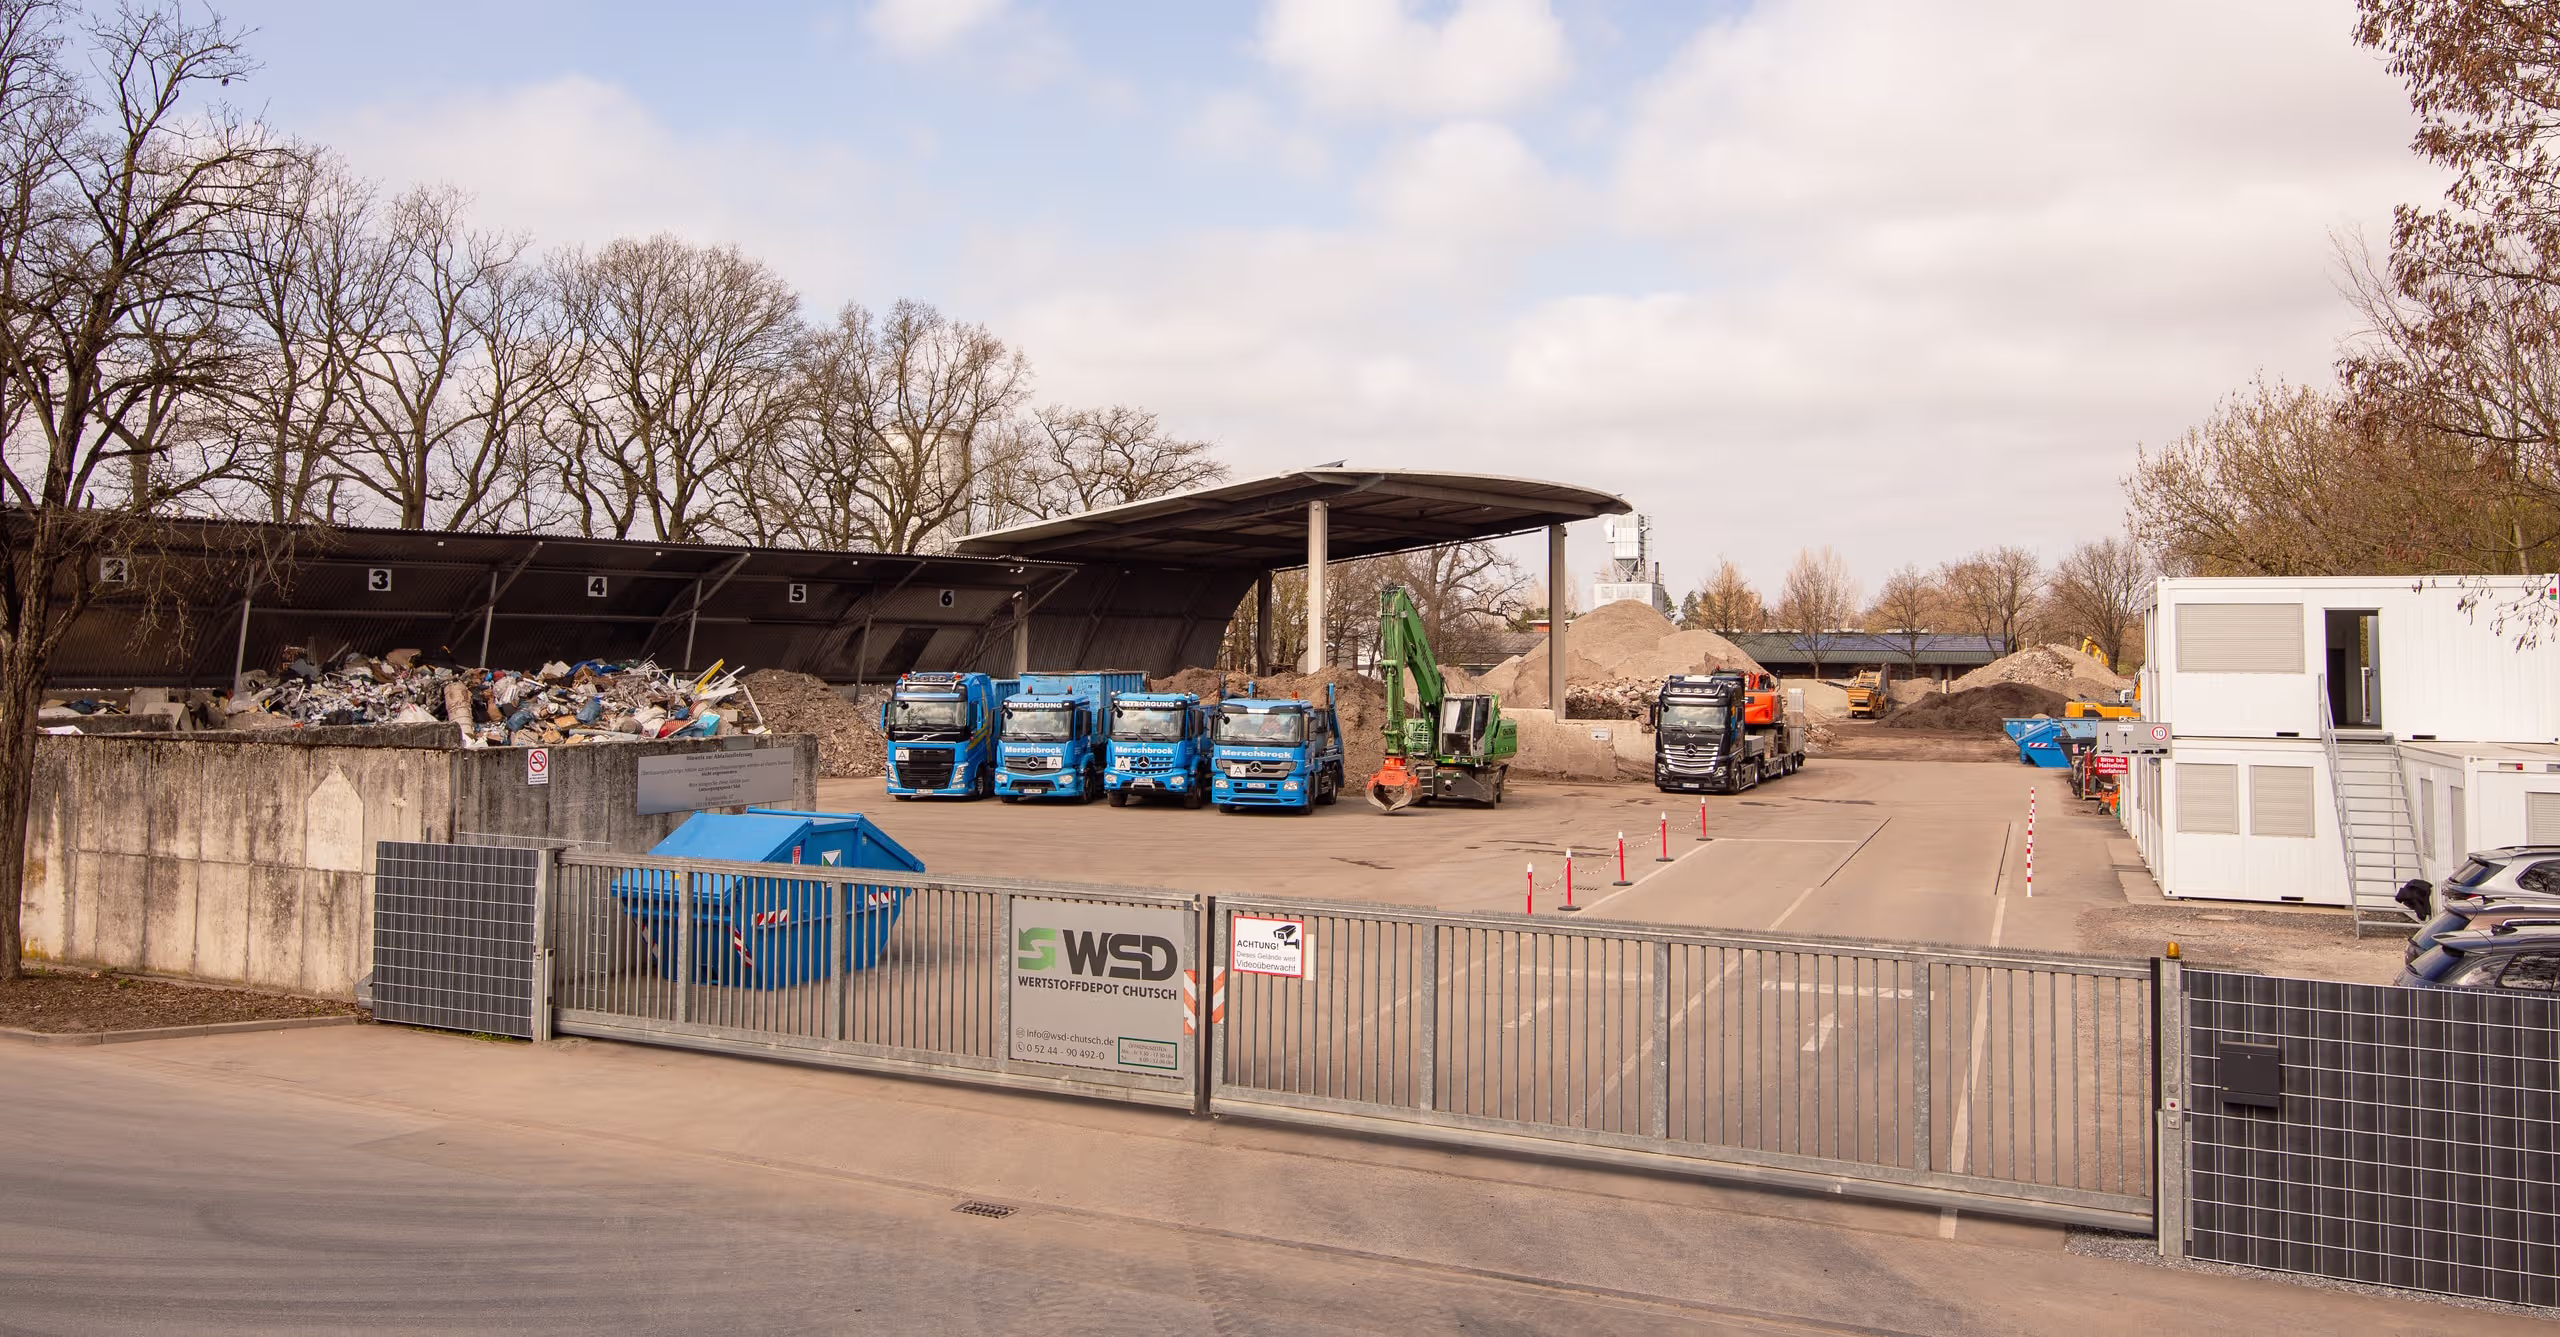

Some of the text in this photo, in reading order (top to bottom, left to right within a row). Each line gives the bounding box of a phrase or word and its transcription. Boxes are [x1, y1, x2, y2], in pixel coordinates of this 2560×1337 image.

[106, 559, 124, 581] 2
[372, 571, 389, 589] 3
[590, 578, 605, 595] 4
[791, 586, 804, 602] 5
[941, 591, 952, 606] 6
[898, 751, 907, 759] A
[1005, 746, 1062, 754] Merschbrock
[1115, 746, 1173, 754] Merschbrock
[1221, 750, 1292, 758] Merschbrock
[1051, 758, 1058, 767] A
[1119, 759, 1127, 768] A
[1233, 767, 1242, 775] A
[1237, 940, 1279, 950] ACHTUNG!
[1062, 929, 1178, 981] WSD
[1236, 960, 1296, 972] Videoüberwacht
[1018, 975, 1177, 1000] WERTSTOFFDEPOT CHUTSCH
[1026, 1044, 1032, 1052] 0
[1034, 1045, 1044, 1054] 52
[1047, 1047, 1058, 1055] 44
[1066, 1048, 1078, 1057] 90
[1079, 1050, 1105, 1061] 492-0
